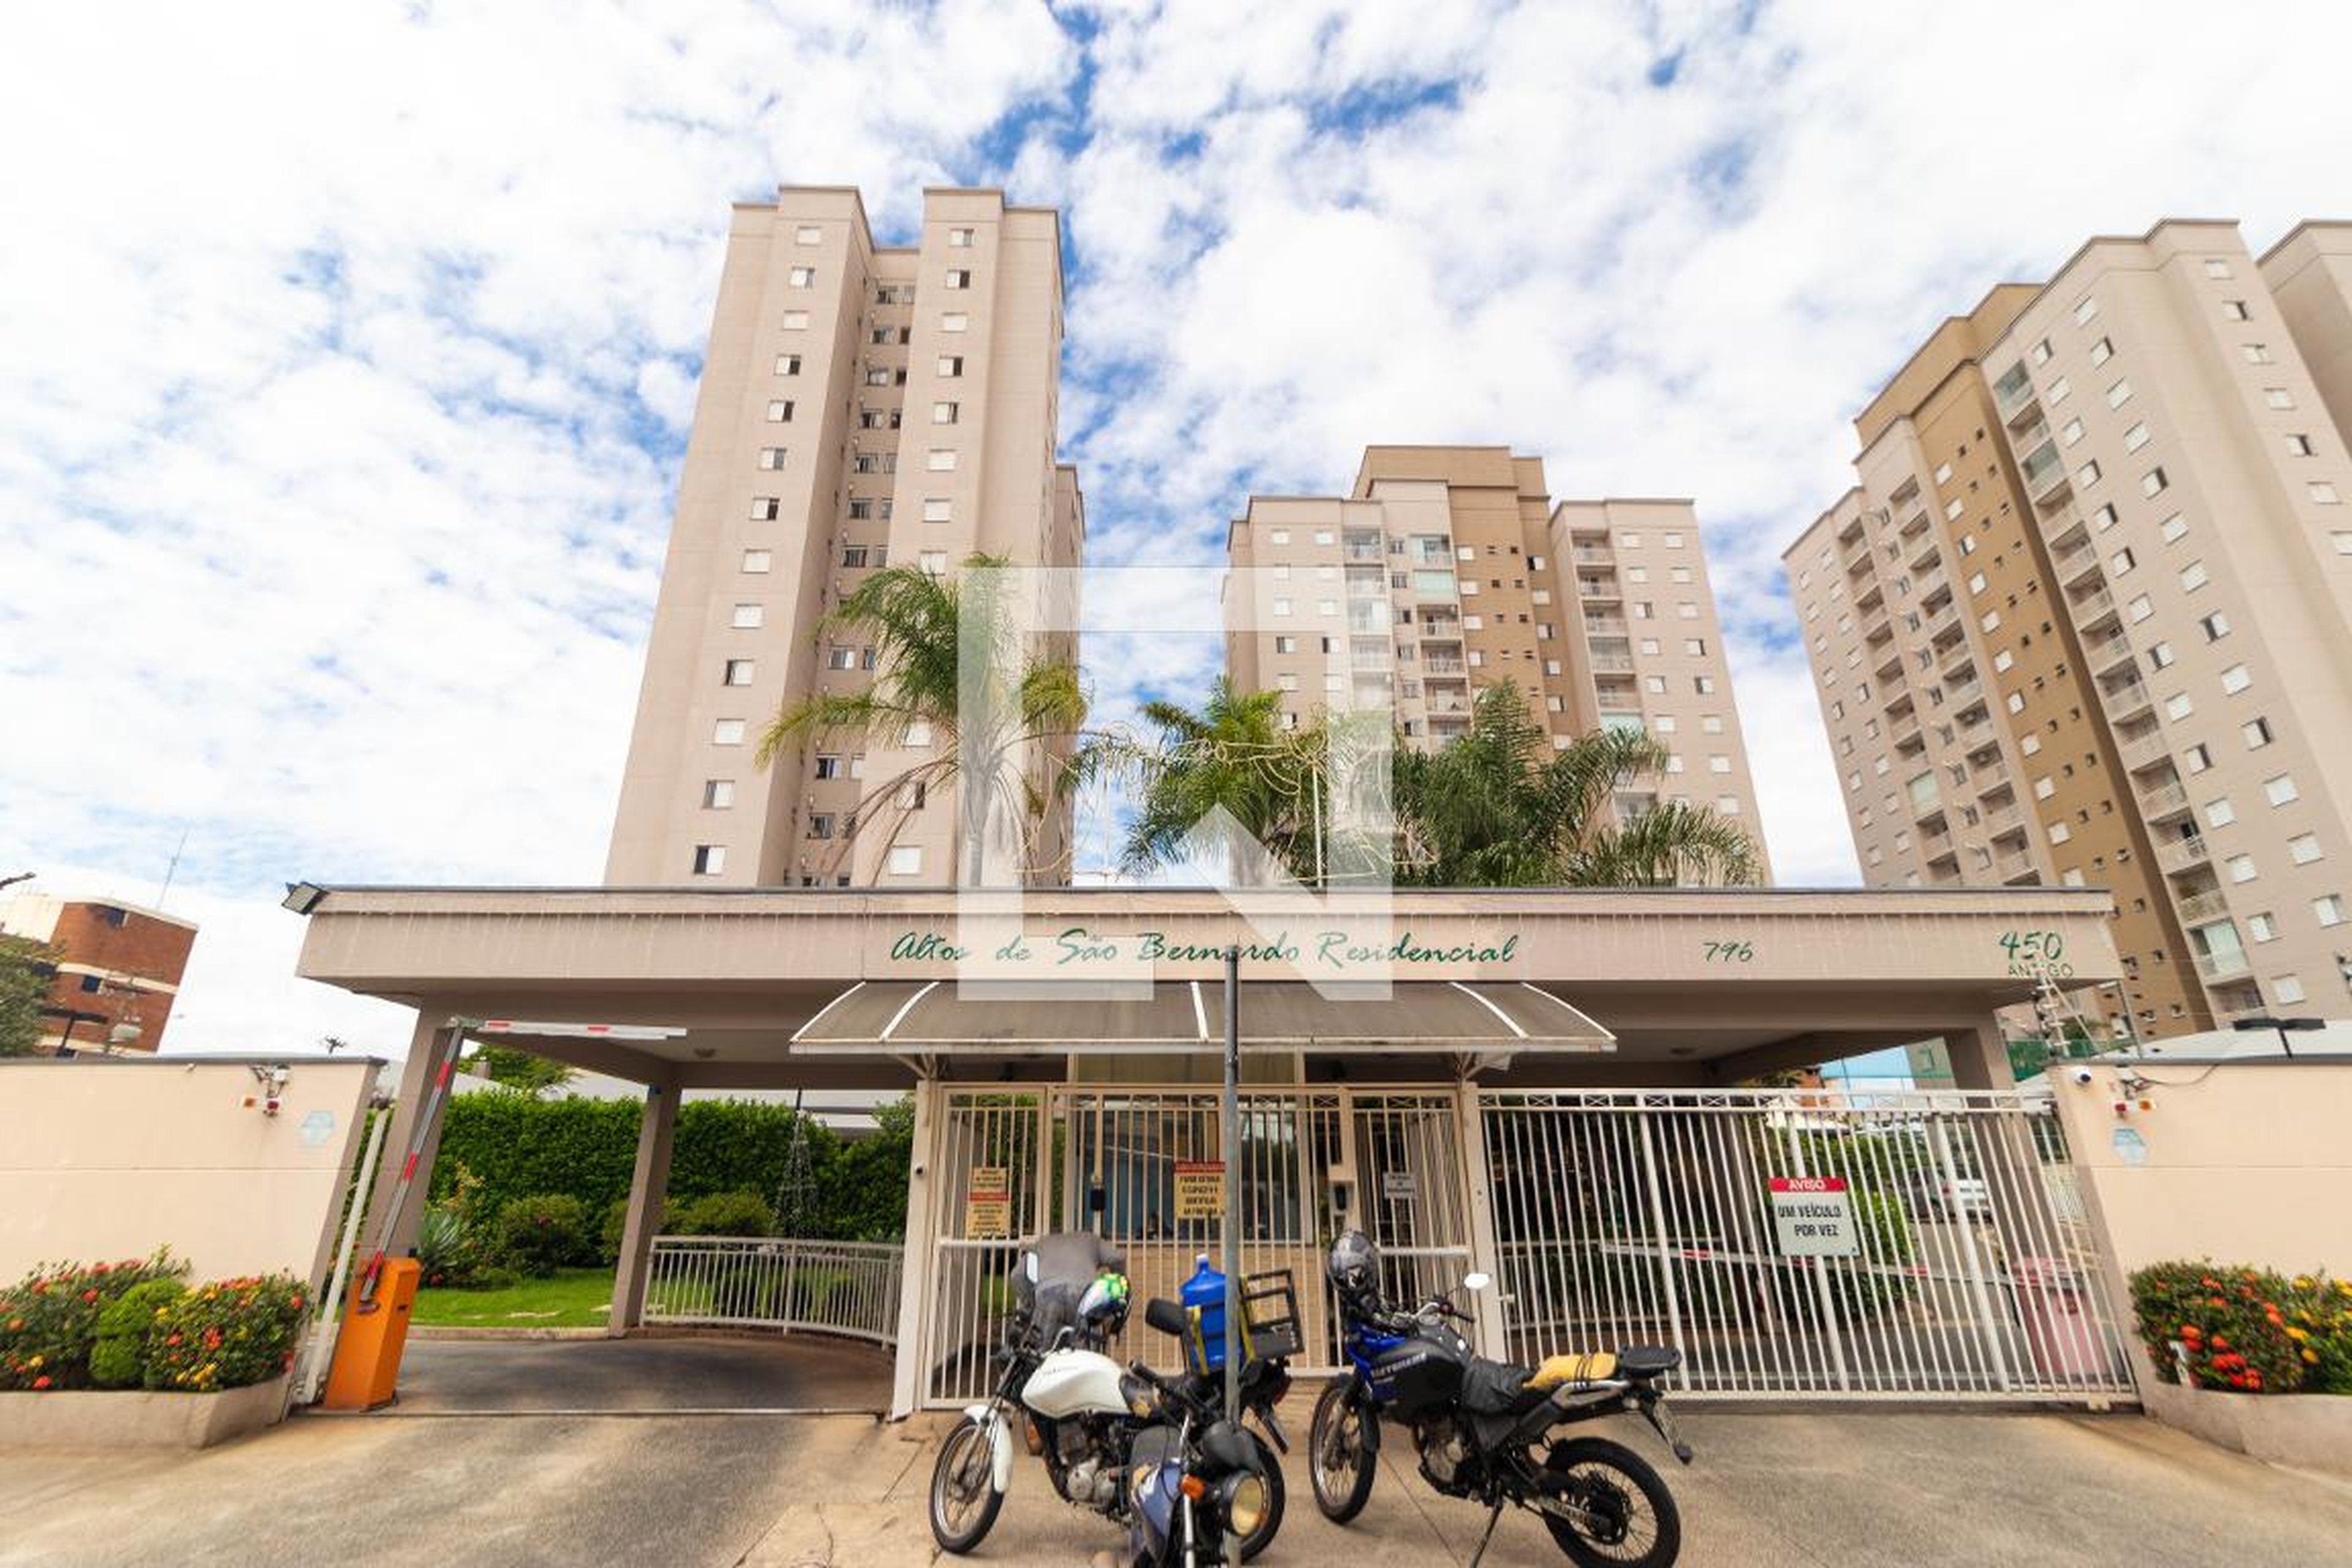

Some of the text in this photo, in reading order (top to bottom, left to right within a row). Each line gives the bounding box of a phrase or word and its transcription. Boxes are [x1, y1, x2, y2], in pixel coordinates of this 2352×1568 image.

[891, 931, 971, 961] Altos
[996, 935, 1032, 962] de
[1057, 928, 1118, 965] São
[1315, 931, 1519, 969] Residencial
[1702, 941, 1752, 962] 796
[1999, 931, 2062, 960] 450
[1788, 1180, 1826, 1190] AVISO
[1778, 1202, 1841, 1218] UM VEÍCULO
[1795, 1225, 1839, 1236] POR VEZ
